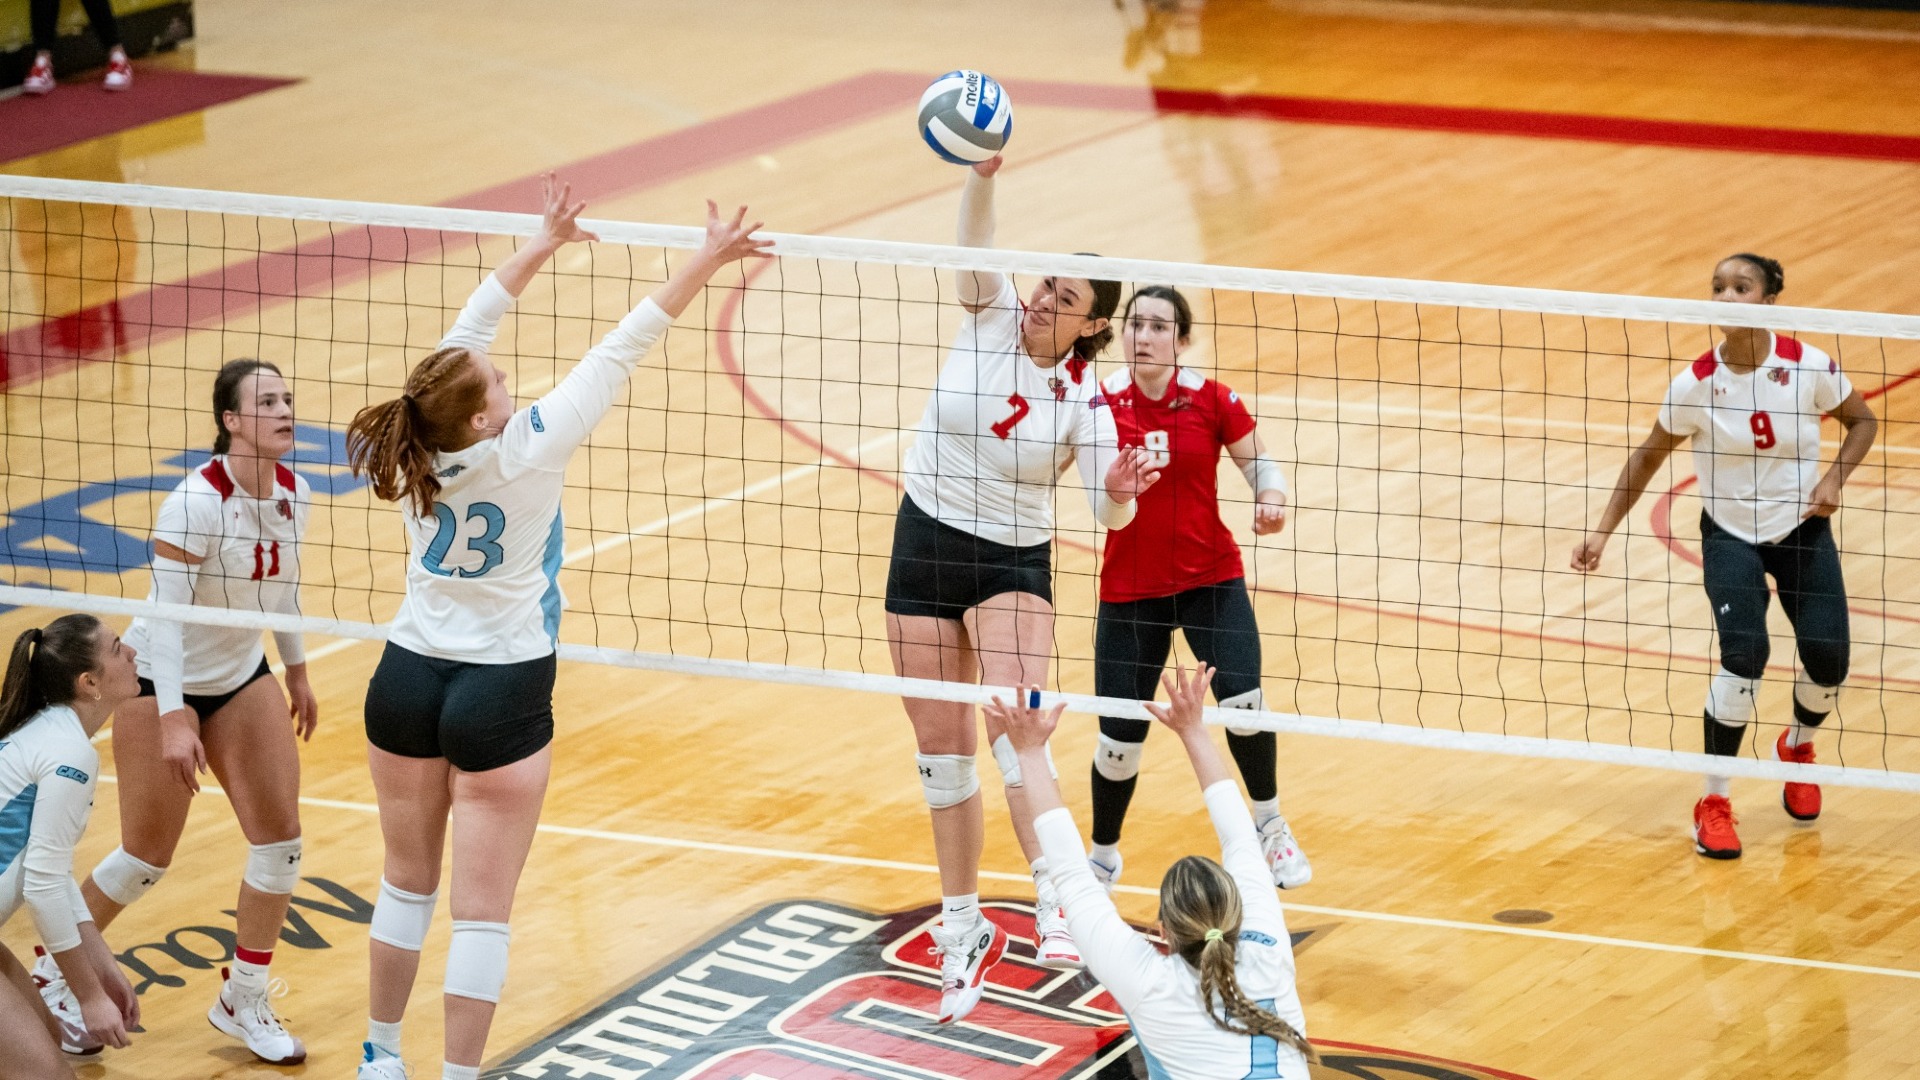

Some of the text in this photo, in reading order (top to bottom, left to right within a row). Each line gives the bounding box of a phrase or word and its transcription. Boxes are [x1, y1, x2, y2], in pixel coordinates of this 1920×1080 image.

[966, 71, 978, 107] molte
[1144, 430, 1171, 468] 8
[1750, 410, 1776, 450] 9
[421, 501, 506, 578] 23
[251, 541, 280, 581] 11
[497, 904, 893, 1080] CALDWE
